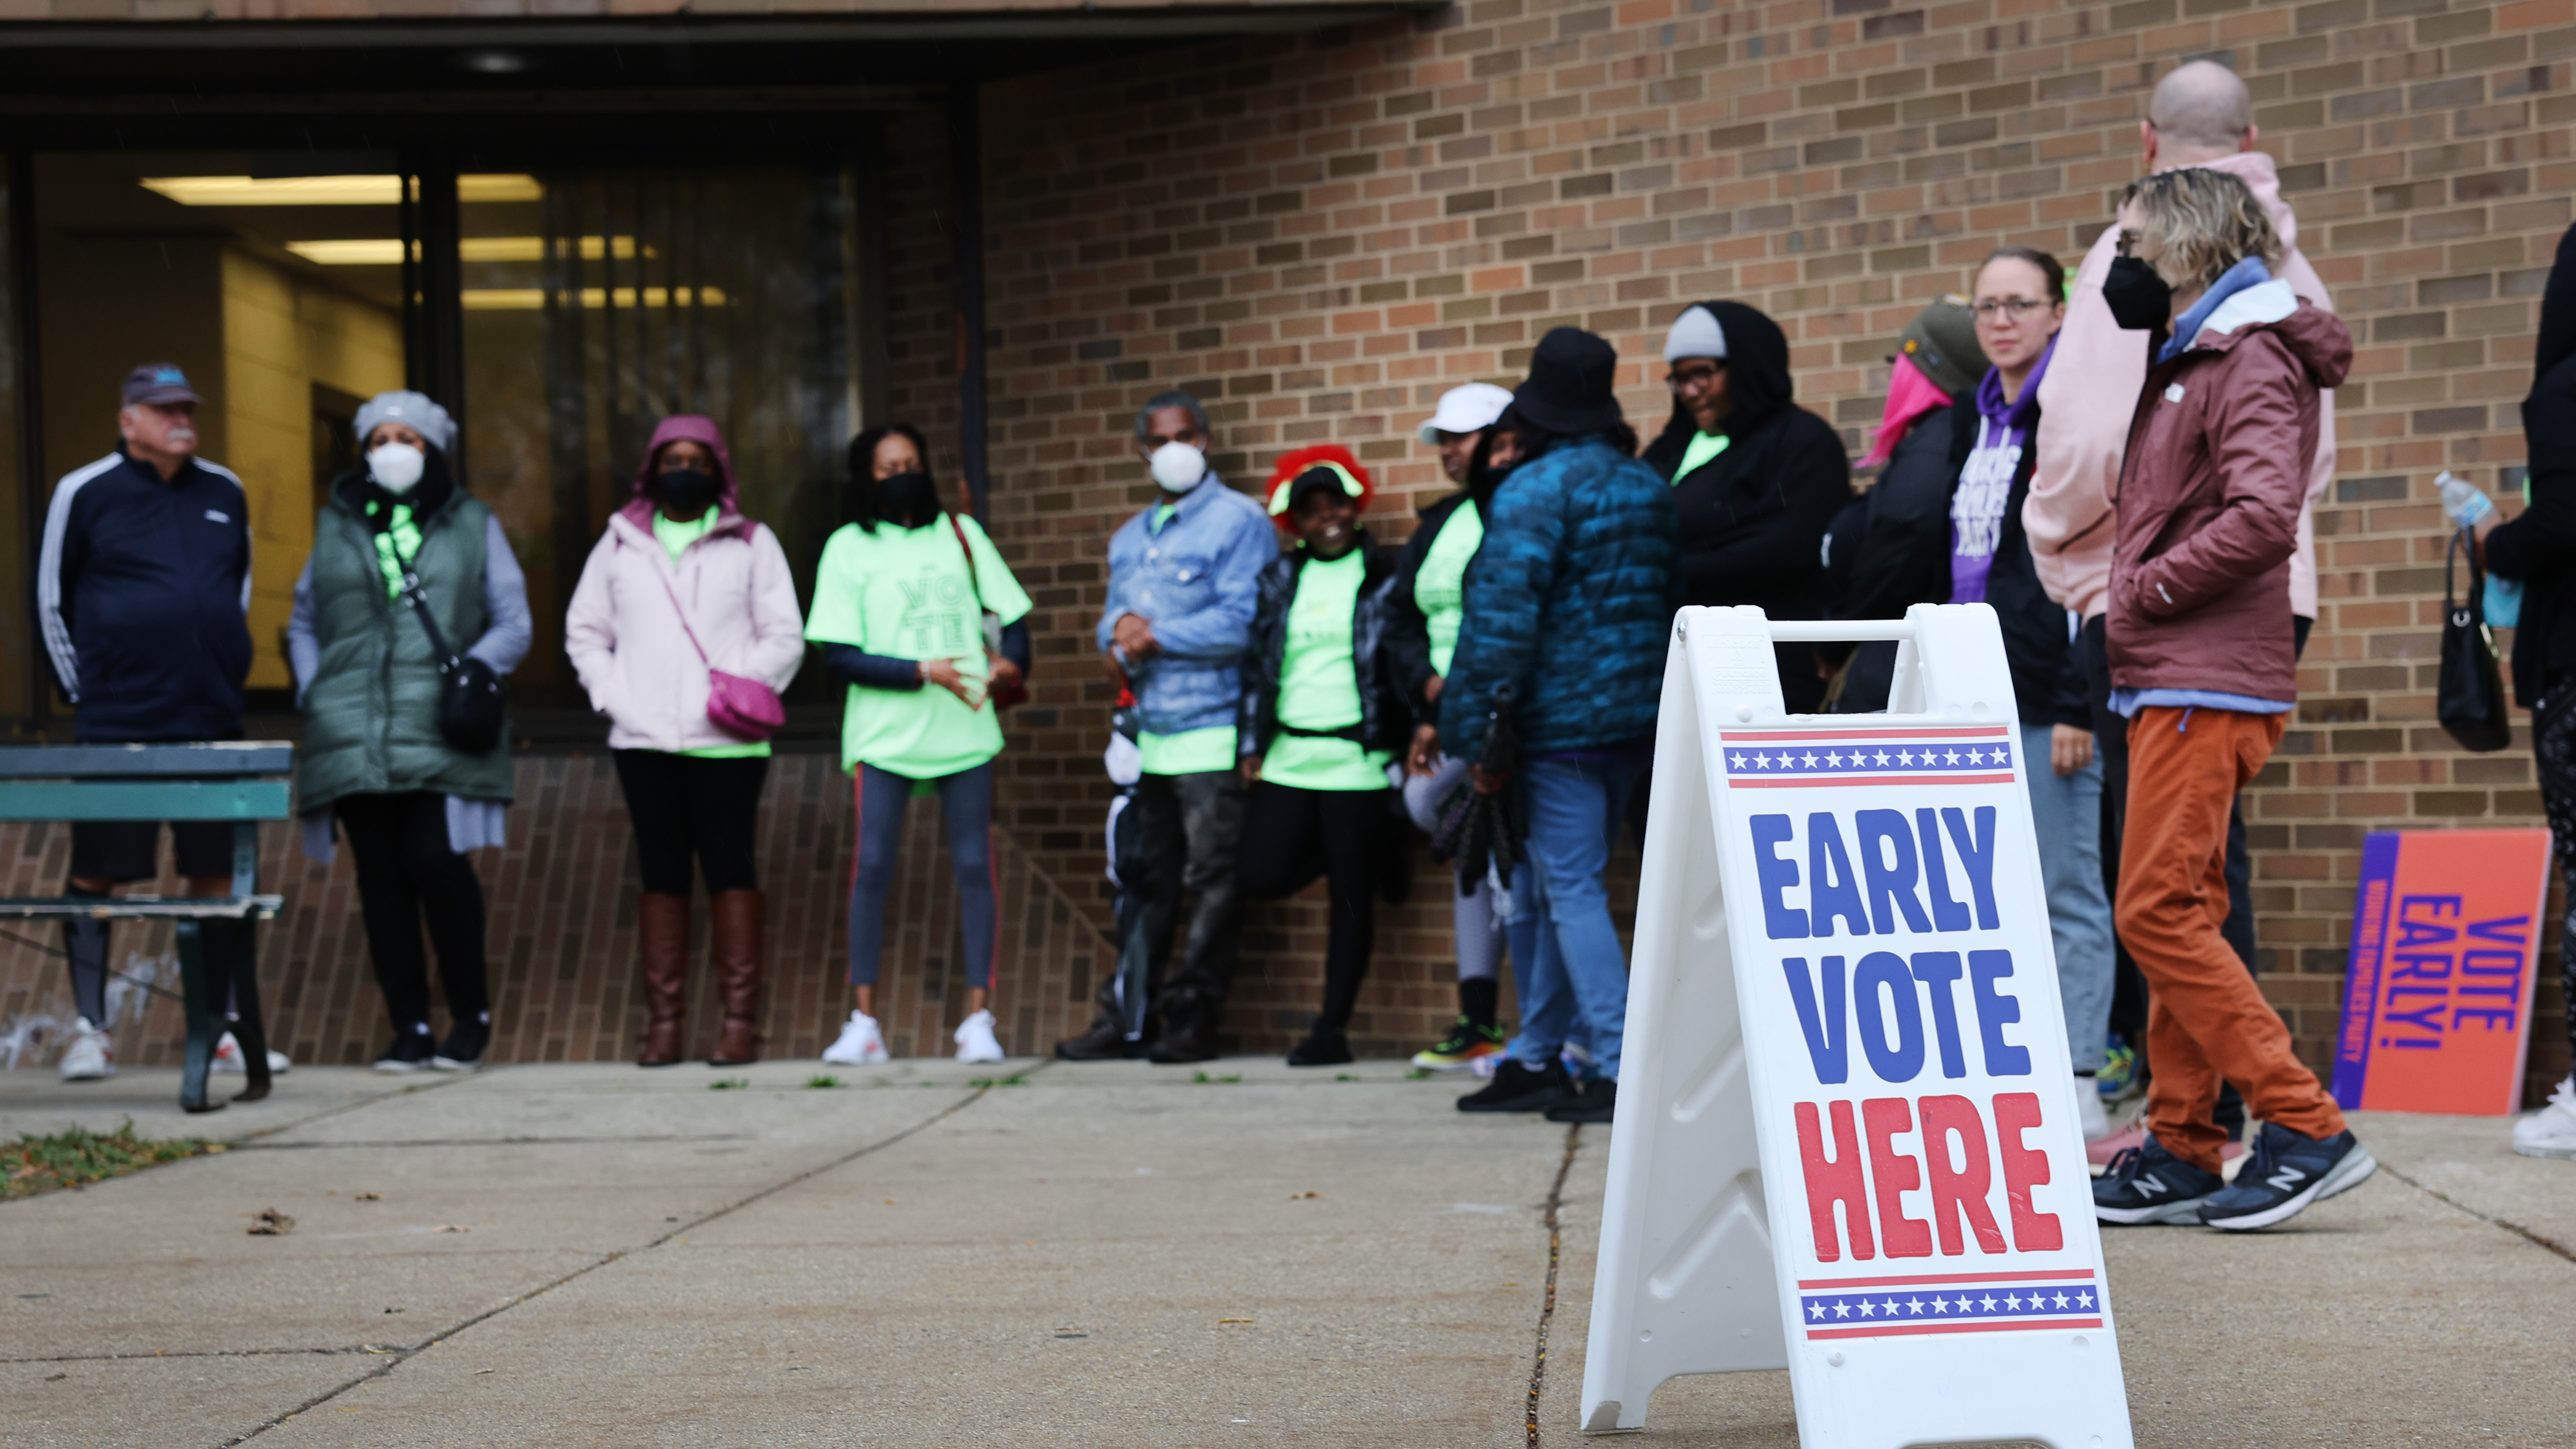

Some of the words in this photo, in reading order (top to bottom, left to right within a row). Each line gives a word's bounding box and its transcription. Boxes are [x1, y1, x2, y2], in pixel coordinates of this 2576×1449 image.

[1750, 806, 2000, 939] EARLY
[1782, 950, 2031, 1084] VOTE
[2381, 894, 2462, 1049] EARLY!
[2453, 915, 2530, 1031] VOTE
[1795, 1093, 2062, 1263] HERE
